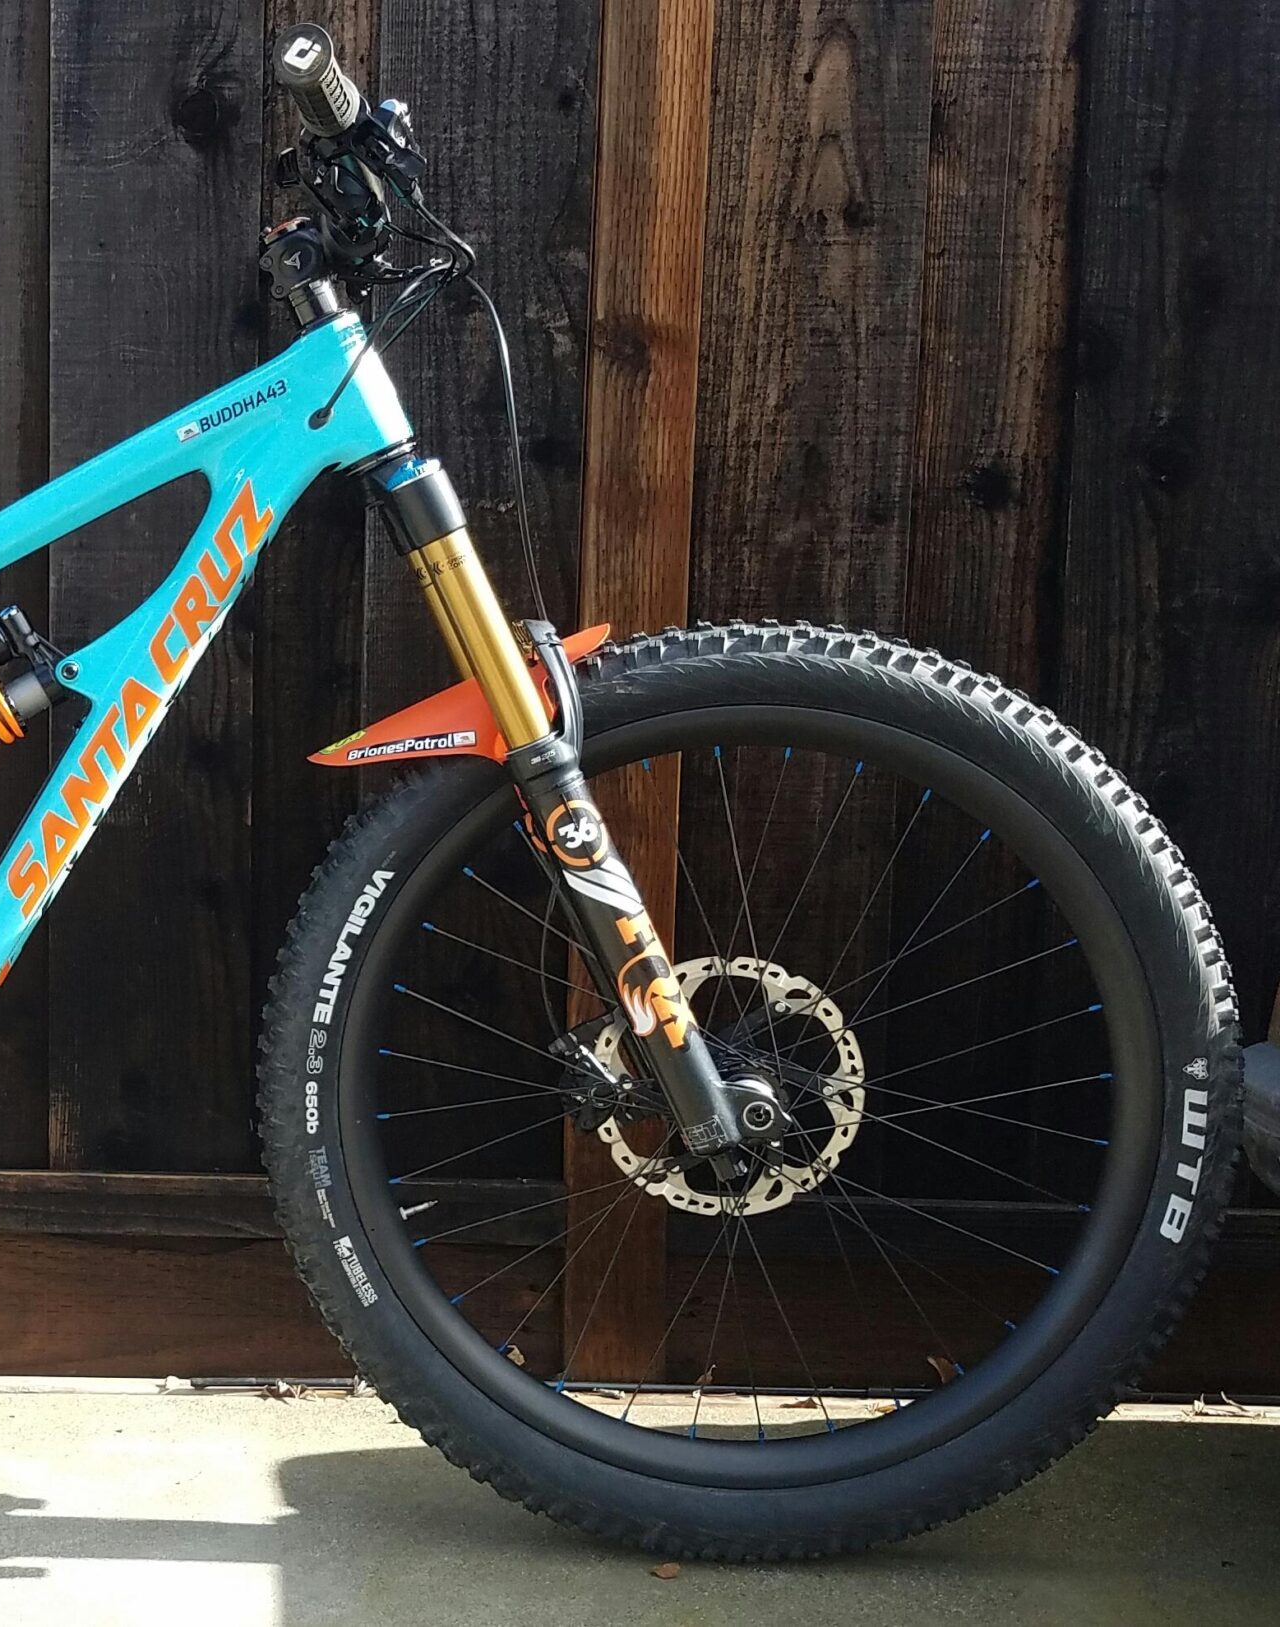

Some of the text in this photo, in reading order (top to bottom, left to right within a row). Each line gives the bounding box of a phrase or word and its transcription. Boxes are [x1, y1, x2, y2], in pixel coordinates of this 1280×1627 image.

[199, 379, 287, 433] BUDDHA43
[7, 479, 274, 920] SANTA CRUZ
[347, 733, 453, 761] BrionesPatrol
[558, 816, 599, 849] 36
[312, 869, 396, 1025] VIGILANTE
[615, 909, 698, 1049] FOX
[306, 1028, 327, 1074] 2.3
[305, 1081, 319, 1135] 650b
[316, 1145, 332, 1187] TEAM
[1159, 1088, 1209, 1244] WTB
[347, 1252, 378, 1305] TUBELESS
